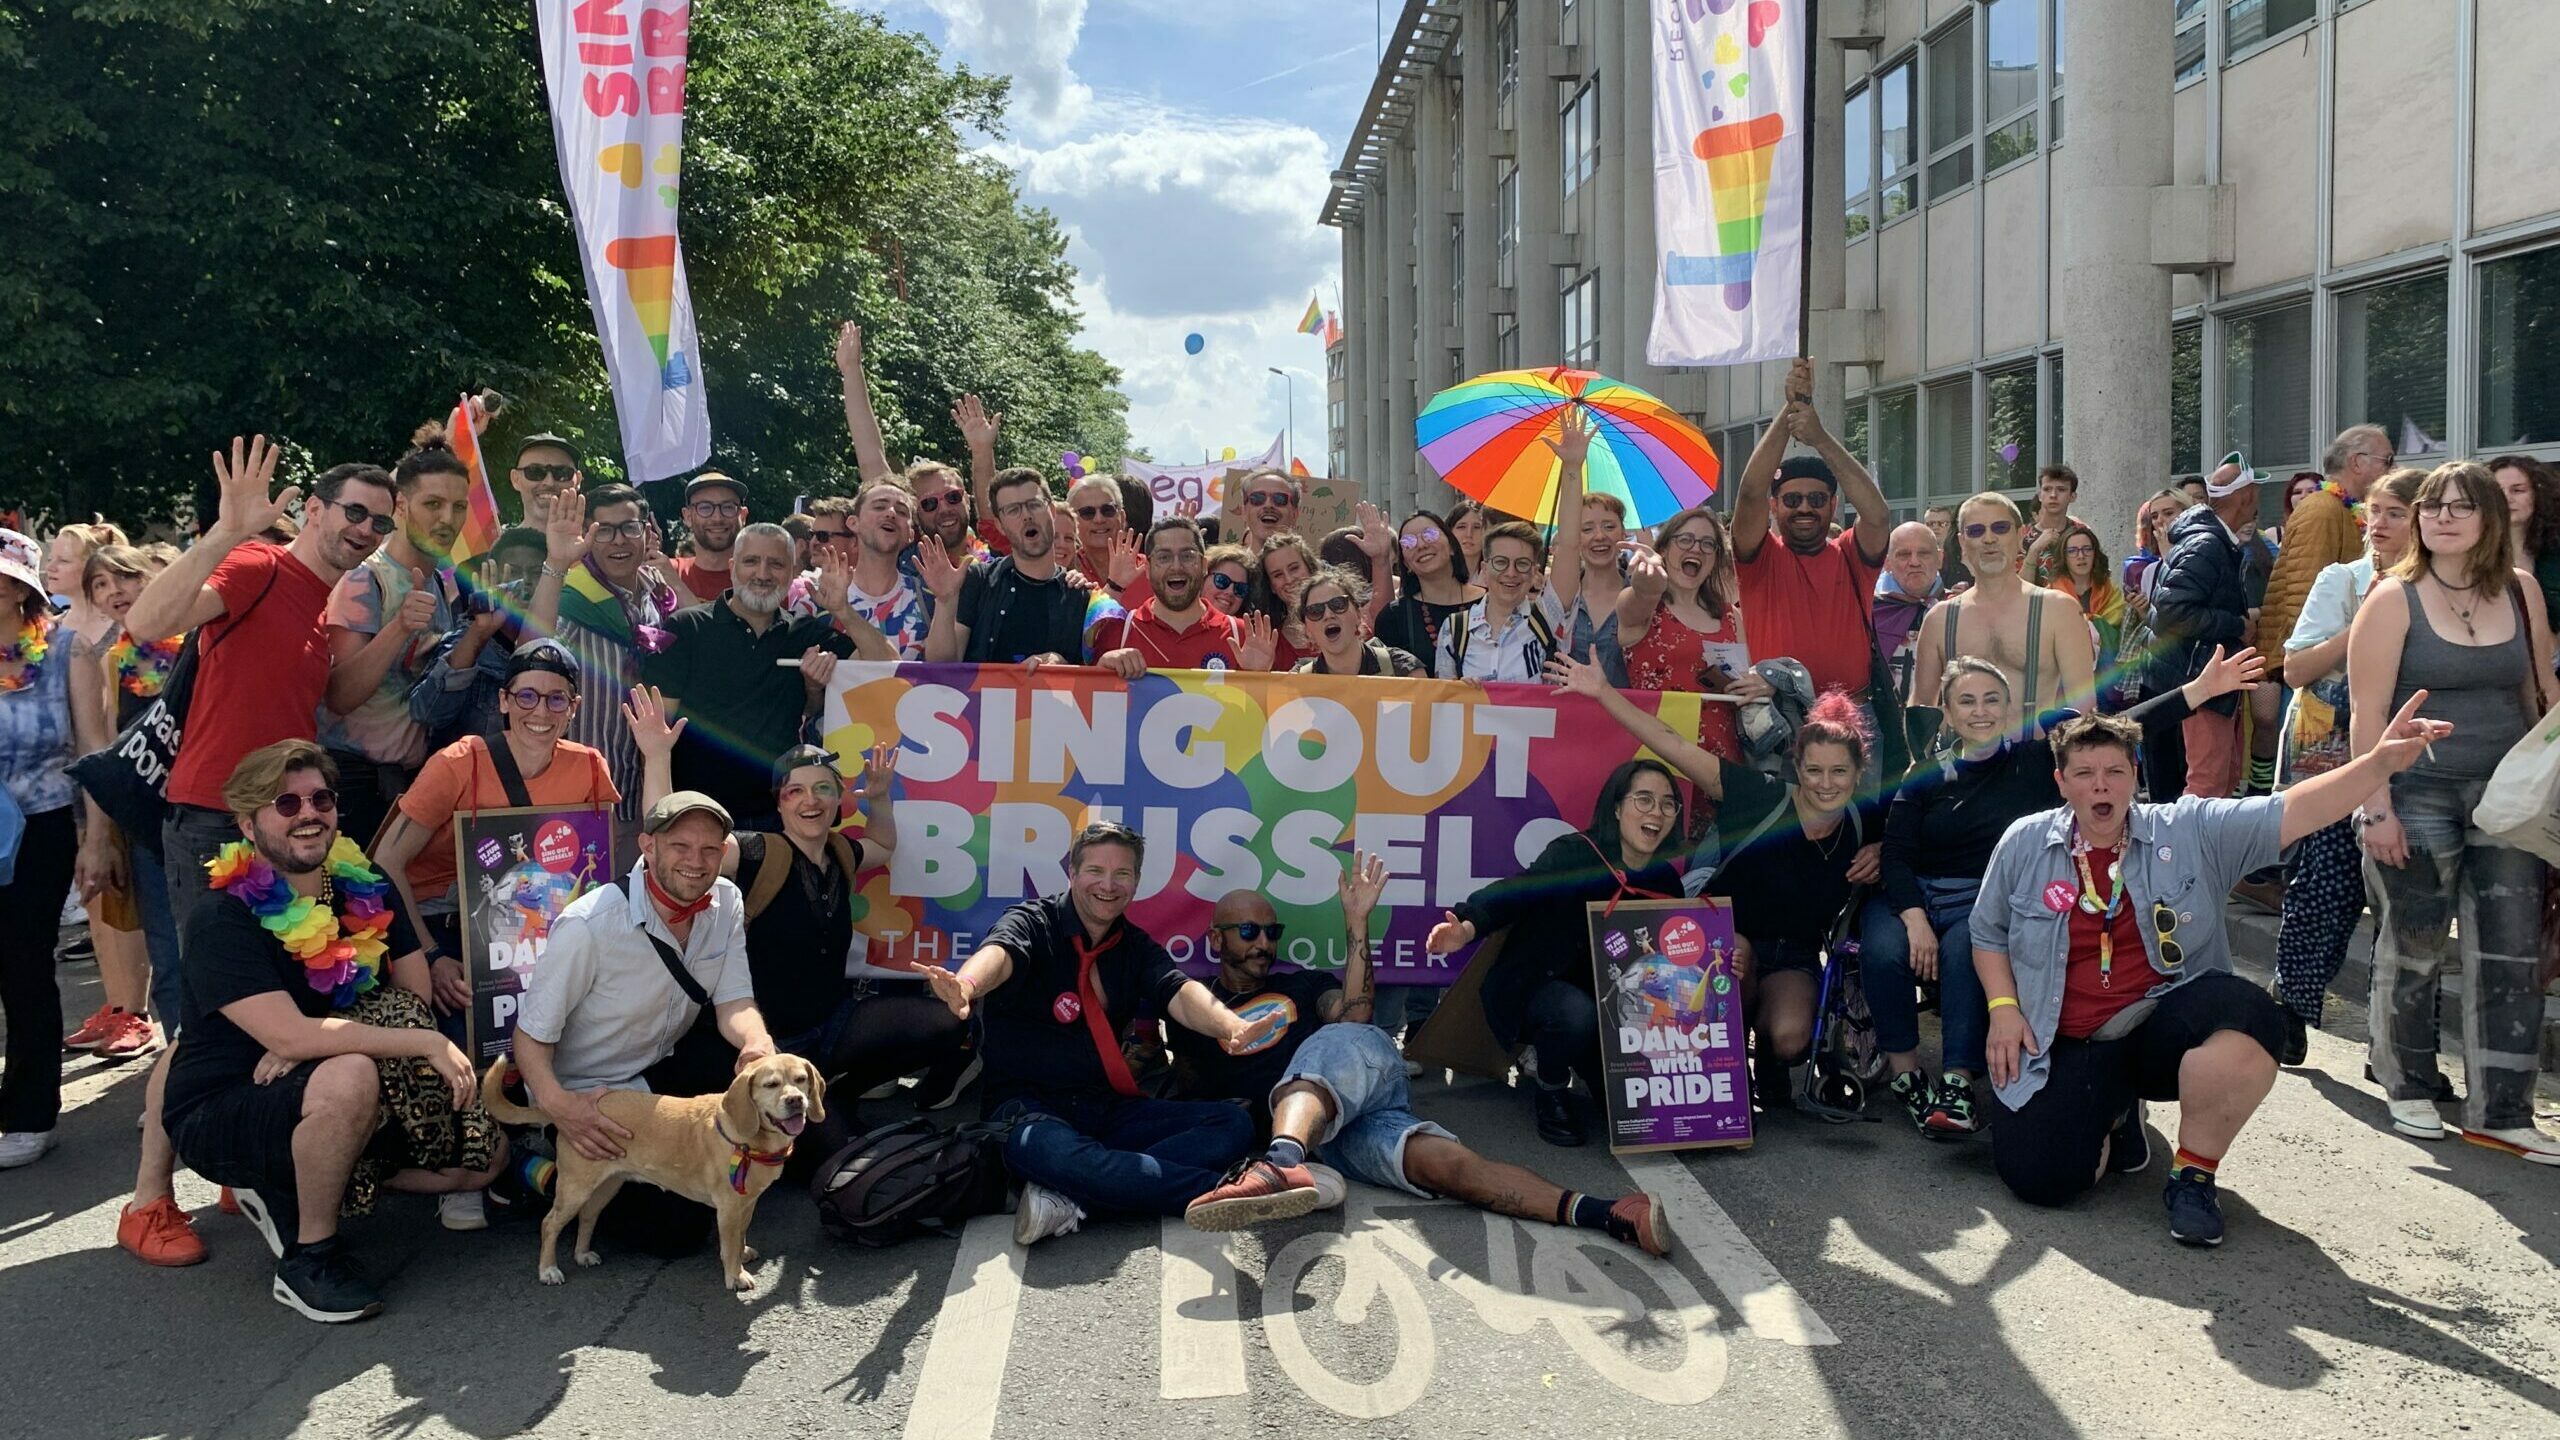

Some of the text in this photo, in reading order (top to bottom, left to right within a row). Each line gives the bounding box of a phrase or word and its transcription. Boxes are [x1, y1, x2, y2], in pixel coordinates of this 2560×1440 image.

[893, 683, 1557, 798] SING OUT
[880, 930, 973, 960] THE
[1619, 1022, 1729, 1053] DANCE
[1650, 1051, 1703, 1074] with
[1625, 1072, 1733, 1108] PRIDE
